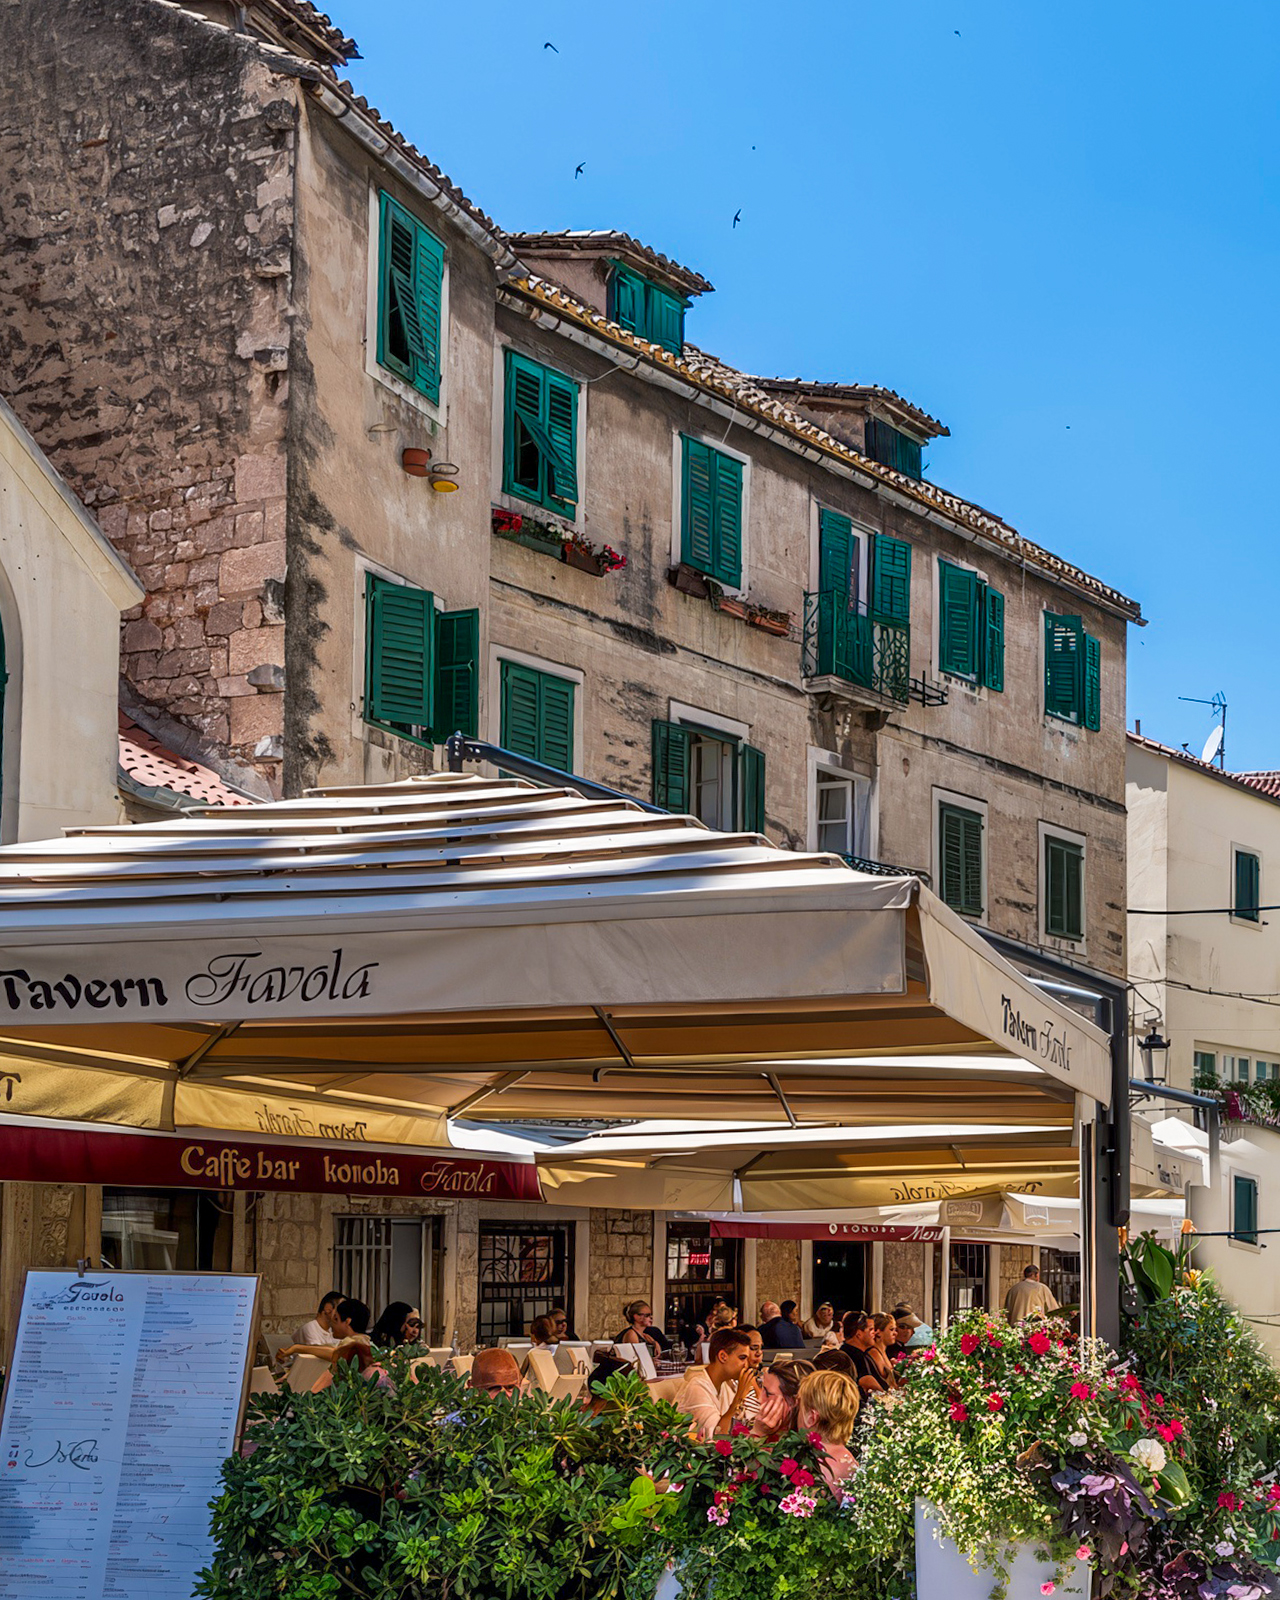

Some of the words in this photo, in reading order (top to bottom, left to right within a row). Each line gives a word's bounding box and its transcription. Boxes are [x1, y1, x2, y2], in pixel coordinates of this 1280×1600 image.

[0, 968, 169, 1010] Tavern
[185, 948, 380, 1006] Favola
[180, 1146, 251, 1186] Caffe
[256, 1151, 300, 1181] bar
[323, 1155, 400, 1186] konoba
